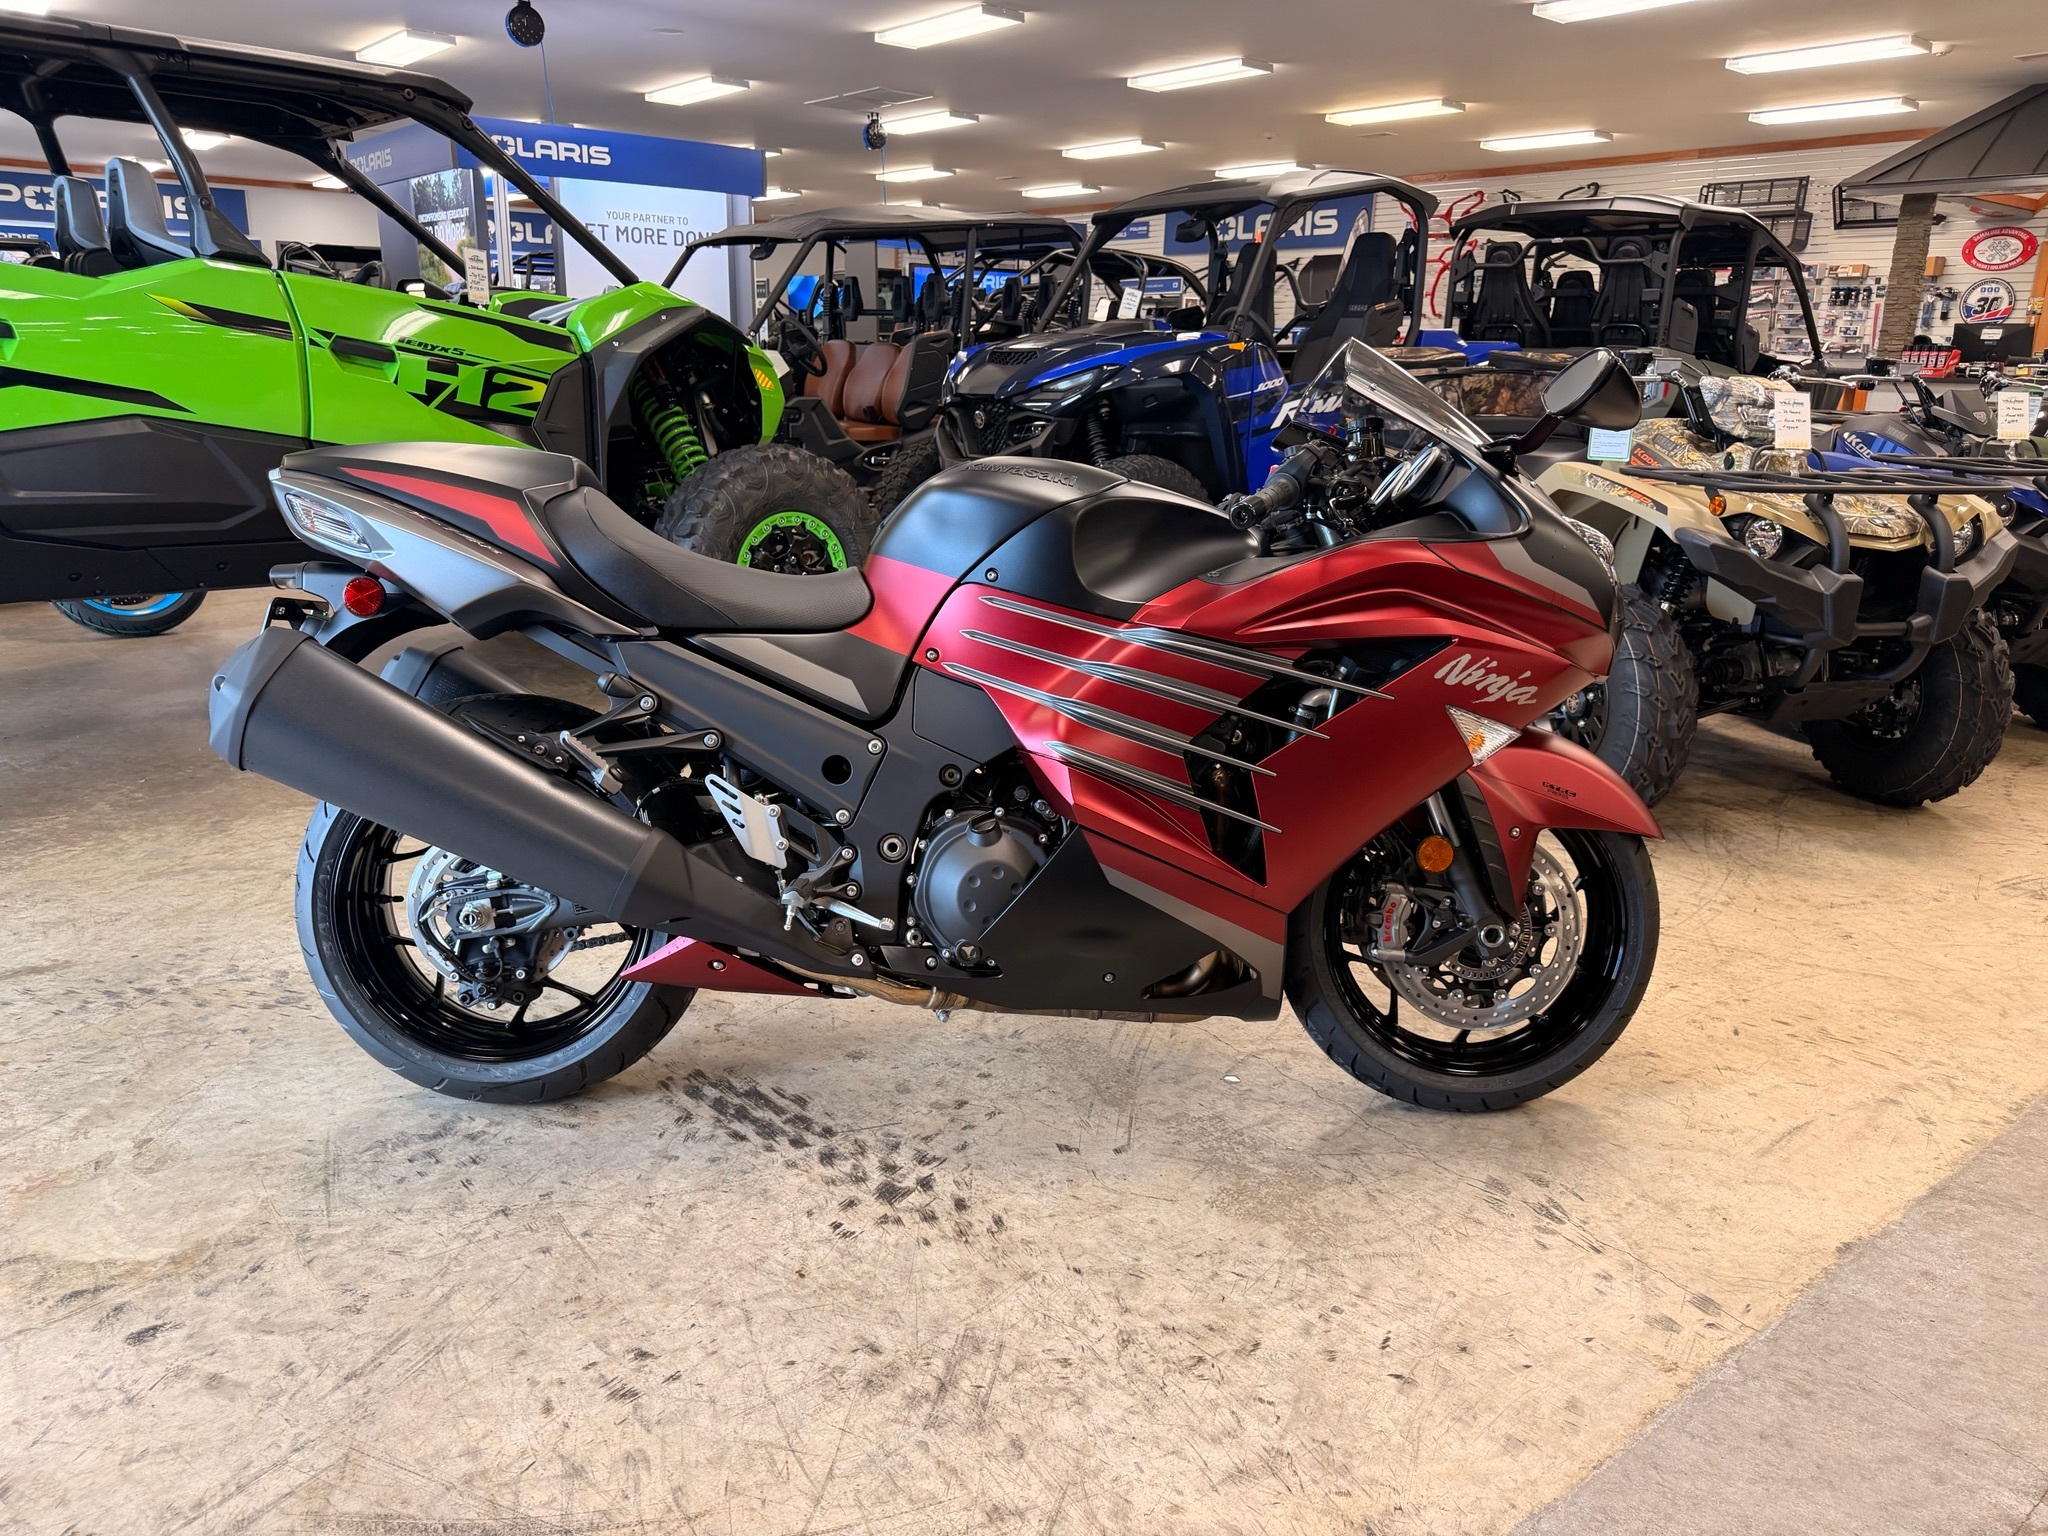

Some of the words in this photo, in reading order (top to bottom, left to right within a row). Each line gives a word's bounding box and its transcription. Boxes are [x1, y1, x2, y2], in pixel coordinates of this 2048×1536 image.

[491, 134, 611, 166] OLARIS
[606, 210, 631, 221] YOUR
[633, 213, 675, 225] PARTNER
[677, 216, 689, 226] TO
[616, 225, 668, 246] MORE
[1254, 376, 1285, 393] 1000
[960, 463, 1078, 488] Kawasaki
[1434, 653, 1538, 705] Ninja
[1383, 901, 1397, 943] brembo
